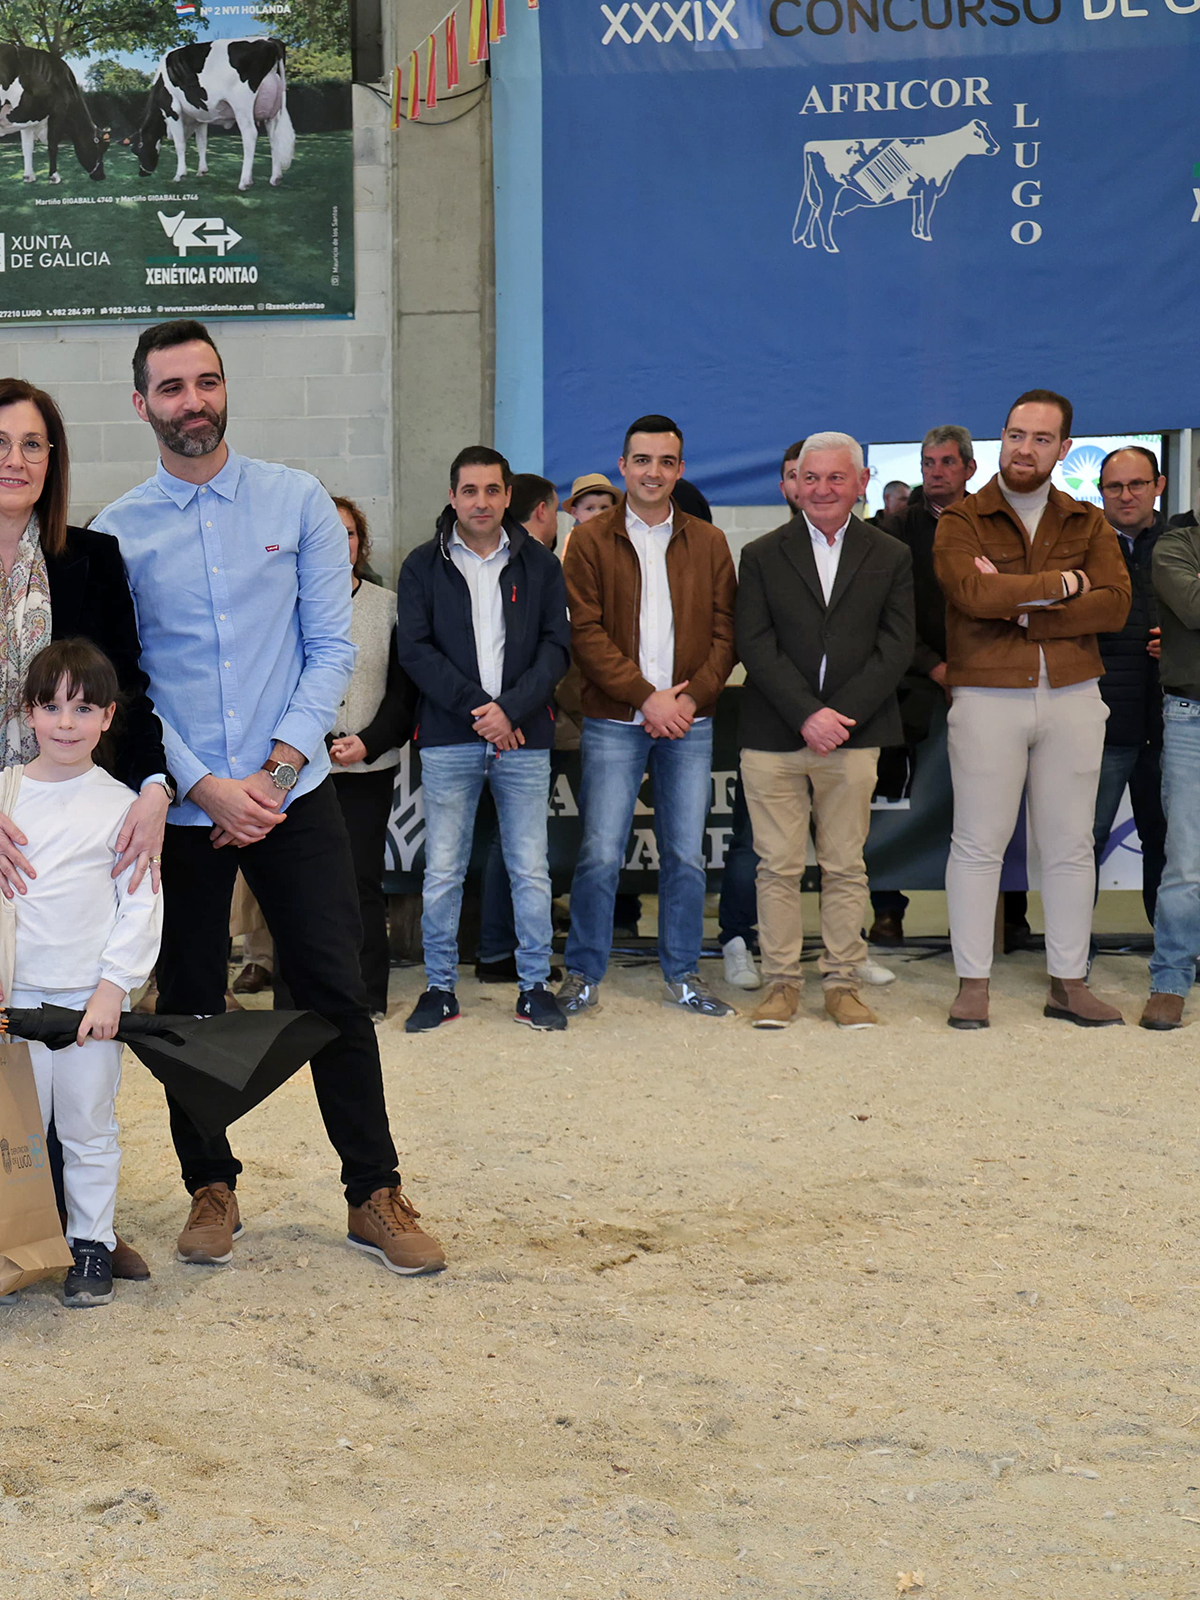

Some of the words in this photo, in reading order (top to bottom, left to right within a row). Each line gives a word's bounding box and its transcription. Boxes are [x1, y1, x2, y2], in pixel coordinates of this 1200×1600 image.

[214, 6, 221, 16] 2
[222, 6, 240, 15] NVI
[241, 4, 291, 14] HOLANDA
[601, 0, 739, 45] XXXIX
[768, 0, 1062, 38] CONCURSO
[798, 76, 993, 115] AFRICOR
[10, 234, 73, 250] XUNTA
[10, 253, 34, 269] DE
[39, 251, 111, 268] GALICIA
[145, 263, 207, 285] XENÉTICA
[209, 266, 258, 285] FONTAO
[21, 309, 42, 318] LUGO
[164, 303, 255, 313] www.xeneticafontao.com
